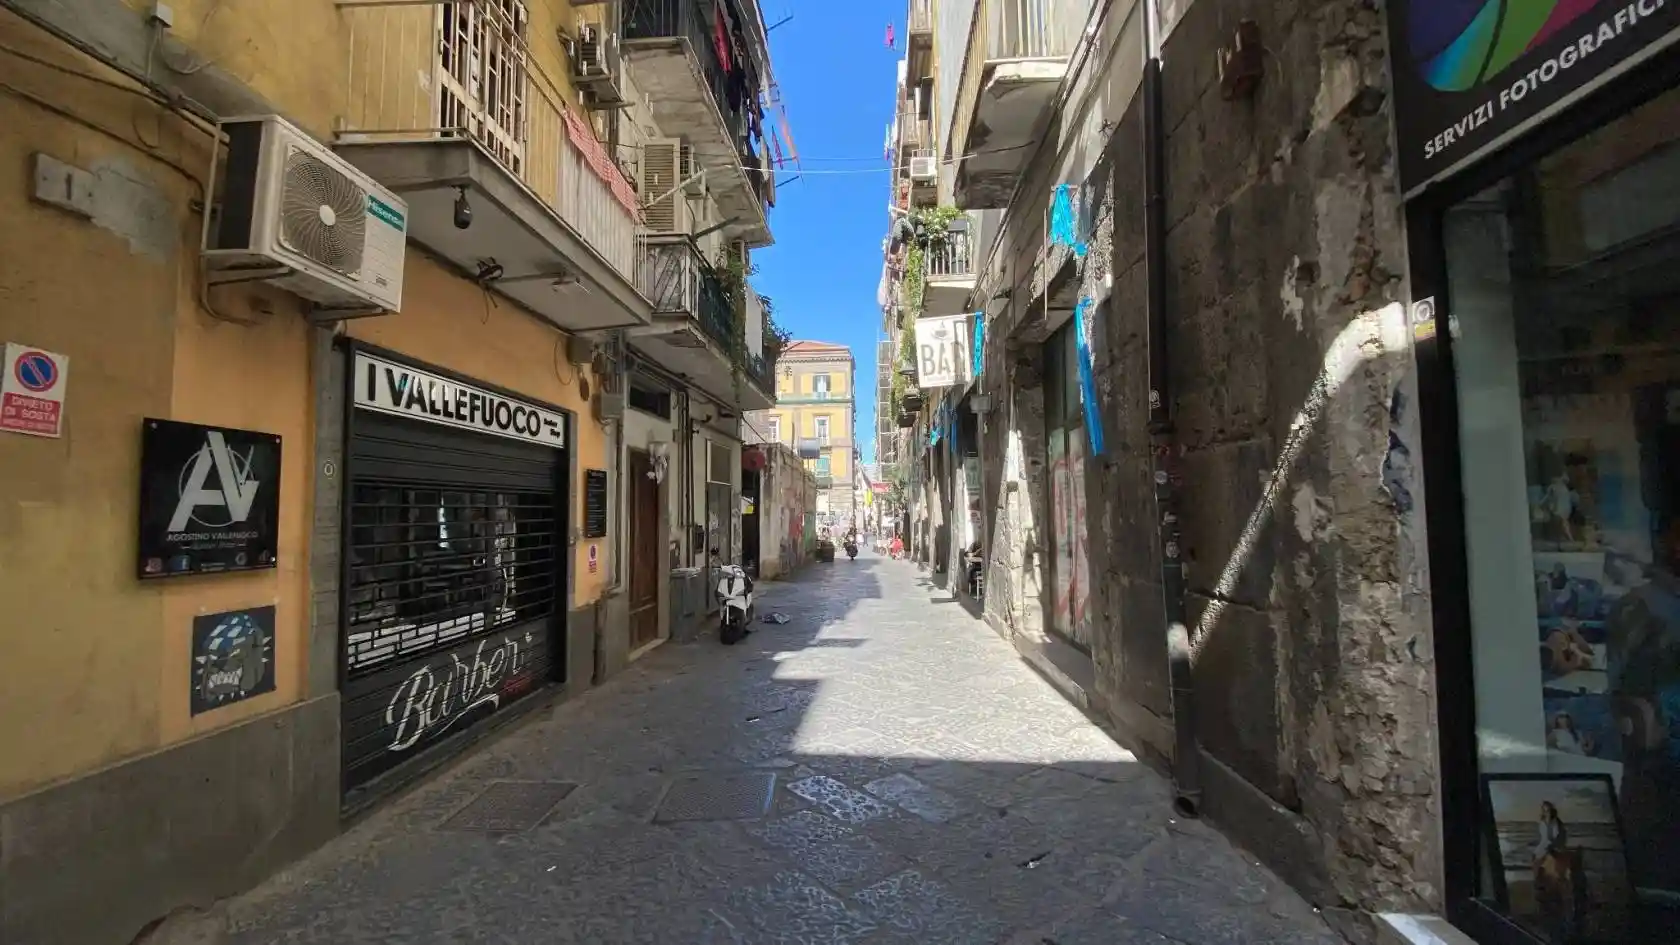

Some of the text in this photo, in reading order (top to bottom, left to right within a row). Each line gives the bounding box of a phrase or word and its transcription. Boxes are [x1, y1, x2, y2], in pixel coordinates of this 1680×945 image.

[1424, 100, 1494, 159] SERVIZI
[22, 408, 56, 422] SOSTA
[368, 363, 541, 437] I VALLEFUOCO
[384, 637, 521, 751] Barber
